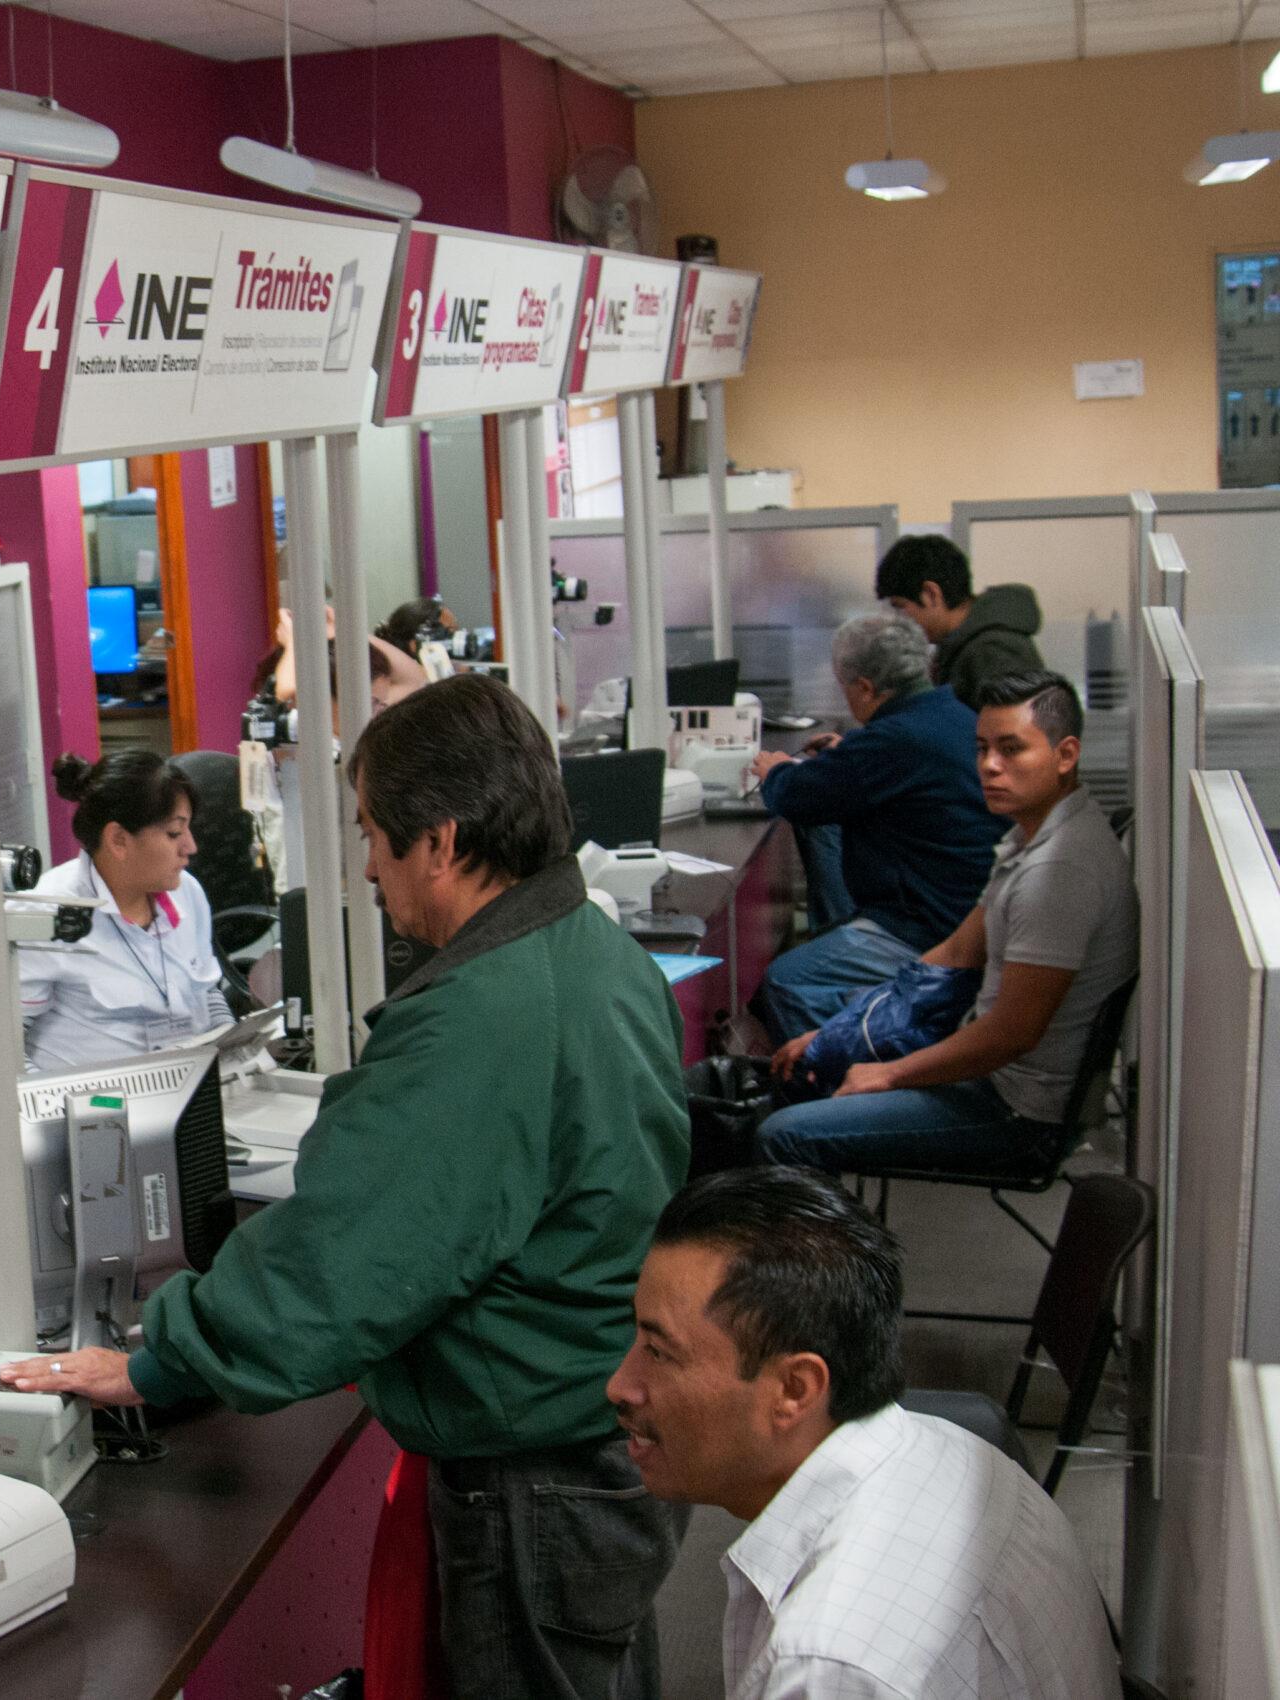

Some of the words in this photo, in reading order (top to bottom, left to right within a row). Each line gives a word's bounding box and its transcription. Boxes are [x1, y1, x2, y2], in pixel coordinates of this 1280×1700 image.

[127, 273, 214, 341] INE
[235, 250, 334, 313] Trámites
[23, 267, 65, 370] 4
[402, 289, 423, 361] 3
[448, 298, 488, 343] INE
[579, 297, 595, 351] 2
[75, 354, 117, 375] Instituto
[118, 354, 160, 373] Nacional
[161, 353, 200, 373] Electoral
